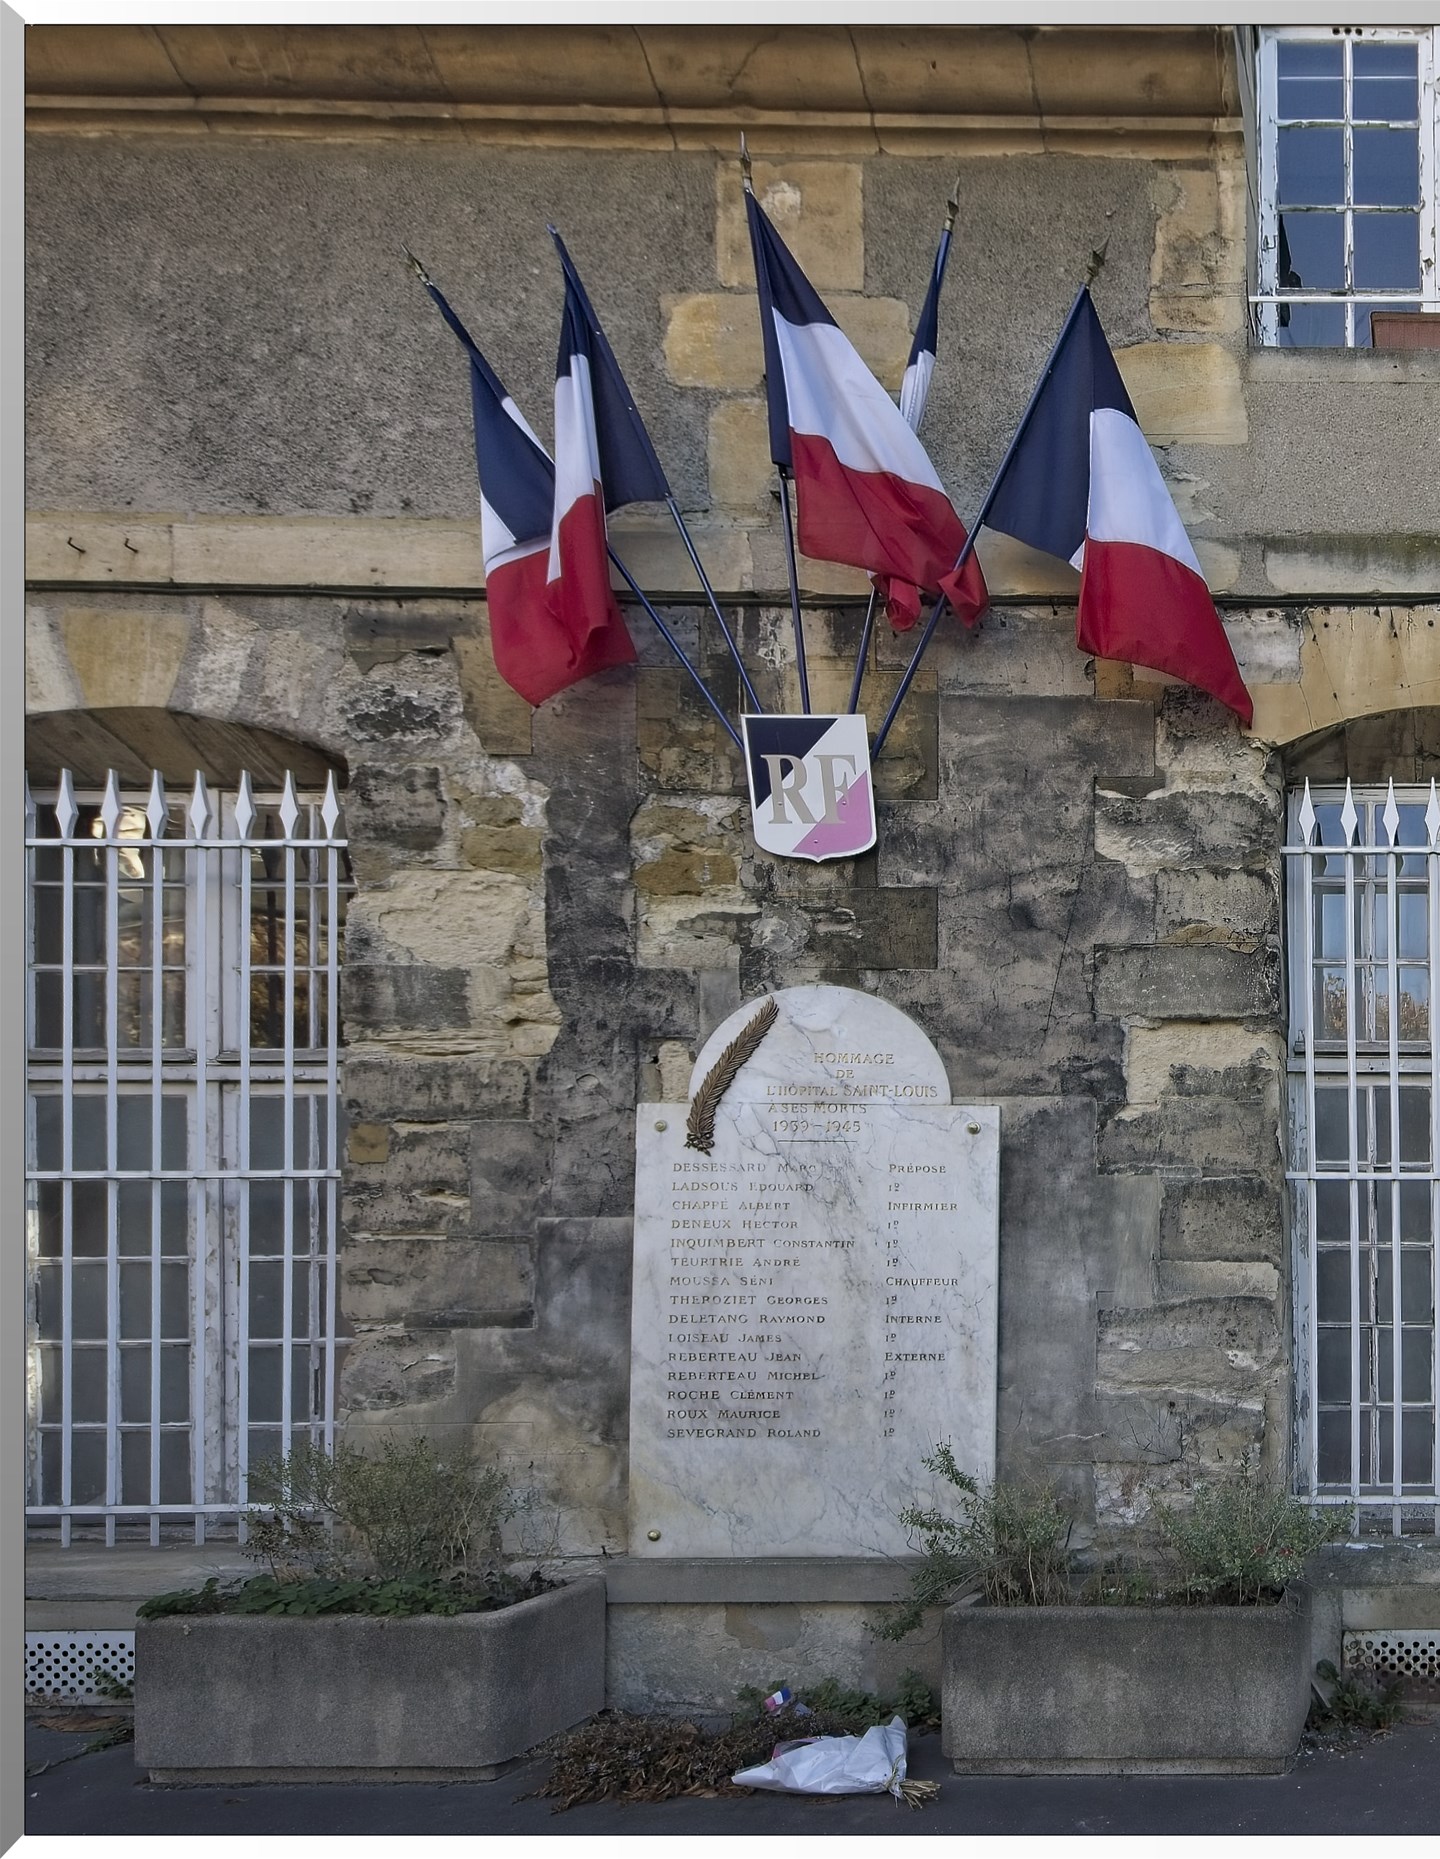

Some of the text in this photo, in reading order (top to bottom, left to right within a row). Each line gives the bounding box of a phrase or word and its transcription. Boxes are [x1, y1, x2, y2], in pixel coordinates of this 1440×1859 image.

[760, 754, 857, 824] RF
[813, 1052, 895, 1065] HOMMAGE
[836, 1068, 854, 1079] DE
[843, 1085, 938, 1098] SAINT-LOUIS
[738, 1201, 791, 1211] ALBERT
[887, 1201, 958, 1212] INFIRMIER
[671, 1219, 732, 1230] DENEUX
[742, 1219, 799, 1230] HECTOR
[670, 1238, 765, 1249] INQUIMBERT
[773, 1238, 855, 1249] CONSTANTIN
[671, 1257, 744, 1267] TEURTRIE
[670, 1276, 730, 1287] MOUSSA
[885, 1276, 959, 1287] CHAUFFEUR
[766, 1295, 829, 1306] GEORGES
[759, 1314, 826, 1324] RAYMOND
[885, 1314, 943, 1324] INTERNE
[738, 1333, 782, 1343] JAMES
[668, 1352, 946, 1363] REBERTEAU JEAN EXTERNE
[667, 1371, 819, 1382] REBERTEAU MICHEL
[667, 1390, 721, 1400] ROCHE
[667, 1409, 781, 1419] ROUX MAURICE
[667, 1428, 821, 1439] SEVEGRAND ROLAND
